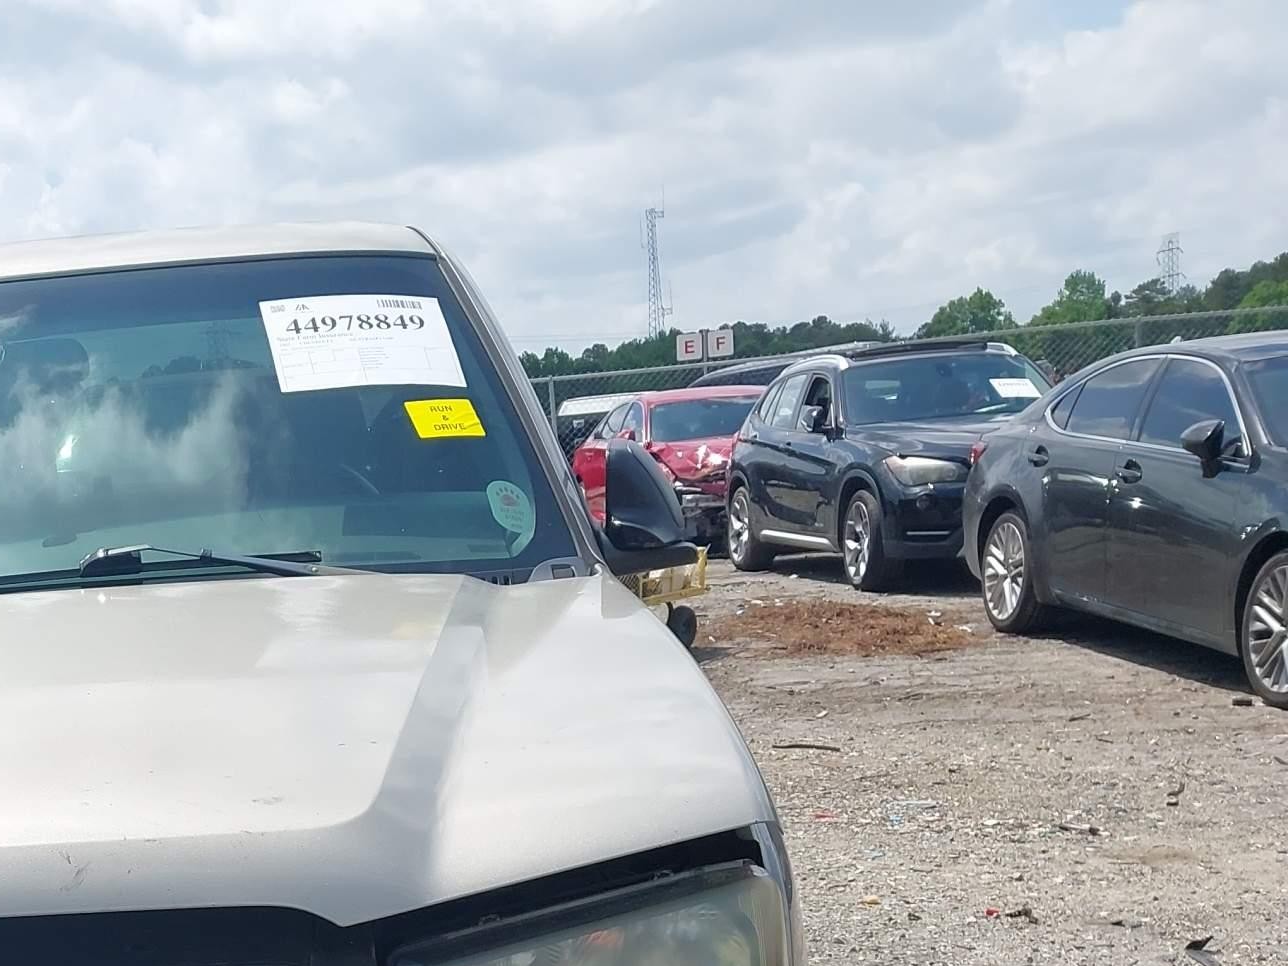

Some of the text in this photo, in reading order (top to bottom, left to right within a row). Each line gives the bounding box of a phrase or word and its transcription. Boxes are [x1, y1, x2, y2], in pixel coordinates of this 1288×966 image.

[285, 313, 425, 335] 44978849
[684, 340, 695, 354] E
[716, 336, 726, 351] F
[429, 405, 453, 413] RUN
[433, 422, 466, 431] DRIVE
